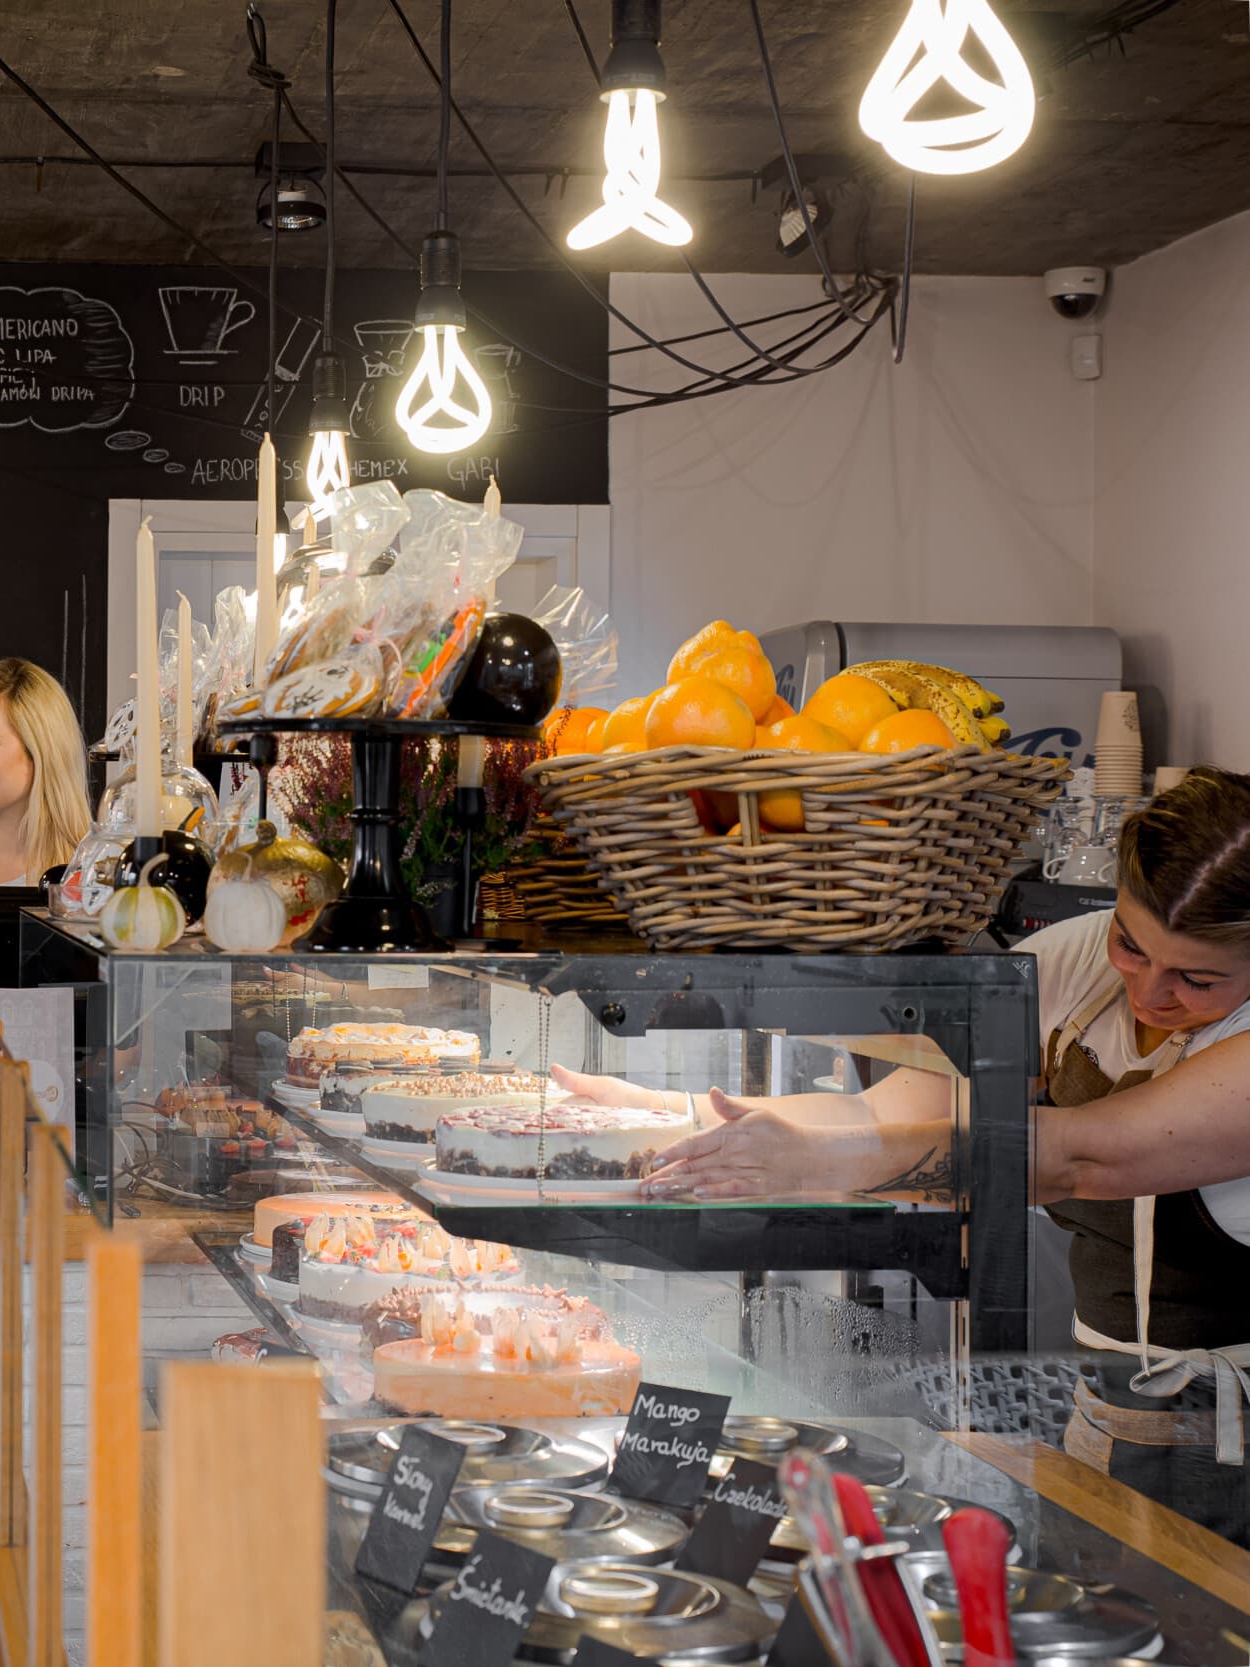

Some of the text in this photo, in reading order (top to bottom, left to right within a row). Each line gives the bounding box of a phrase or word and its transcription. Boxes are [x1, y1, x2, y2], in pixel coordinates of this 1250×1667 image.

[179, 385, 225, 407] DRIP
[191, 457, 304, 485] AEROPSS
[350, 458, 409, 478] HEMEX
[446, 456, 500, 491] GABI
[634, 1394, 700, 1427] Mango
[621, 1432, 710, 1470] Marakuja
